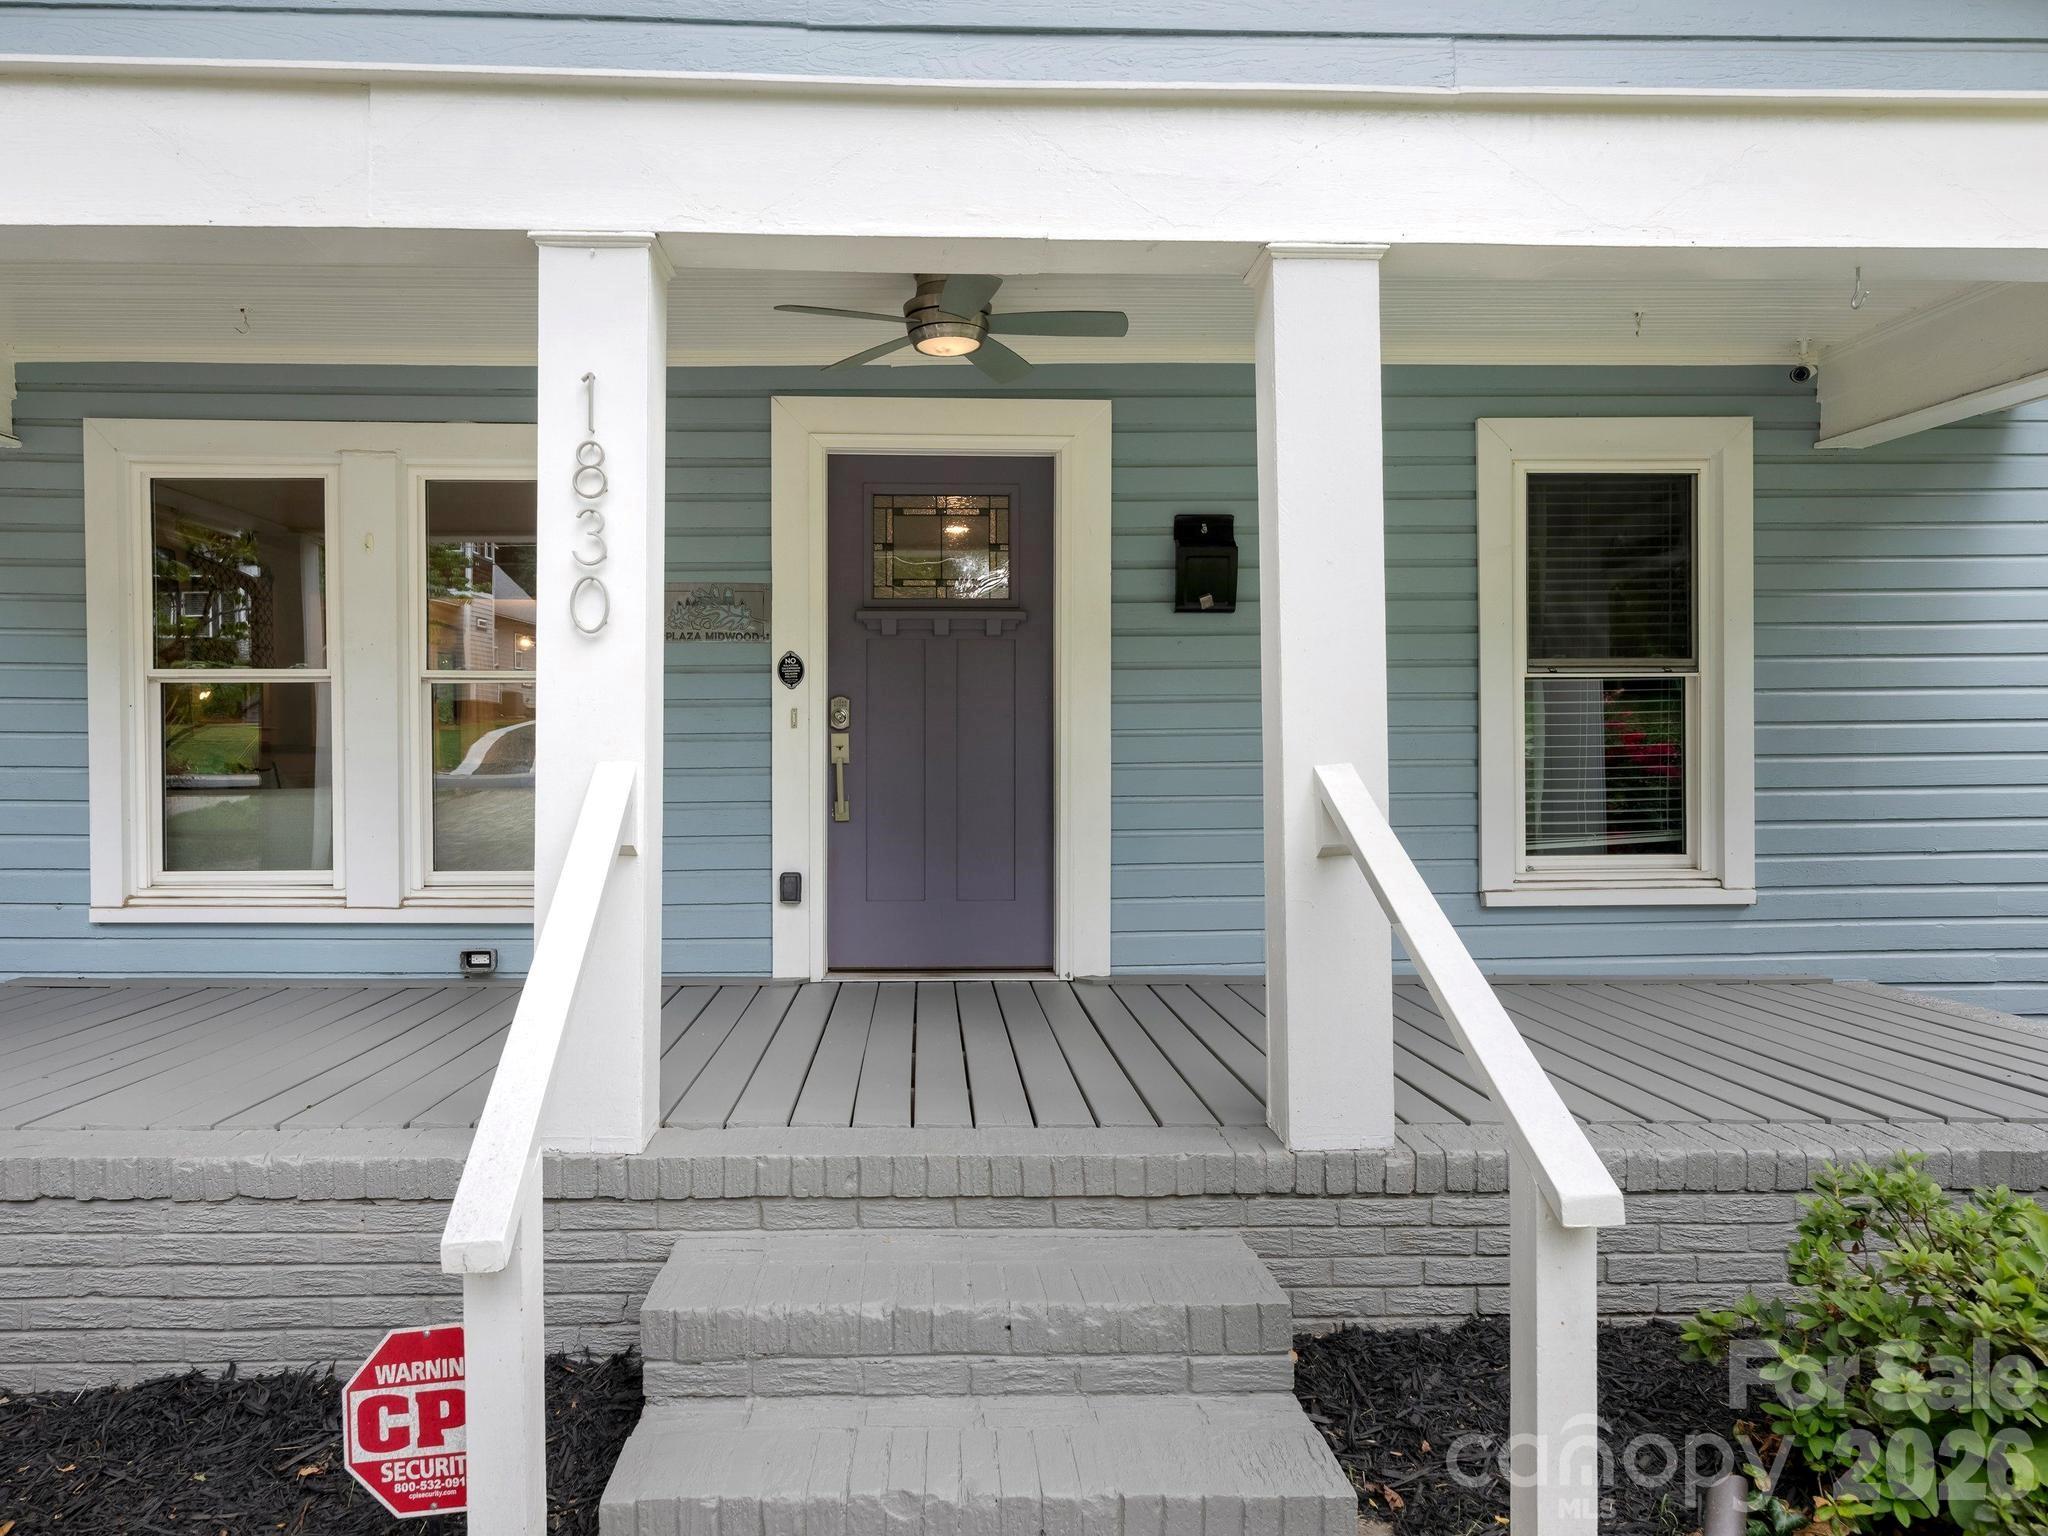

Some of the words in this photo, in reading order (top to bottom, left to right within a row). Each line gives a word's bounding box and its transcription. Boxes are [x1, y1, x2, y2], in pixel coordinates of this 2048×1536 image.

[570, 371, 610, 634] 1830
[665, 631, 701, 641] PLAZA
[705, 631, 759, 641] MIDWOOD
[784, 657, 797, 665] NO
[374, 1357, 464, 1385] WARNIN
[357, 1388, 466, 1453] CP
[380, 1455, 467, 1483] SECURIT
[394, 1476, 466, 1494] 800-532-091
[408, 1489, 457, 1500] cpisecurity.com
